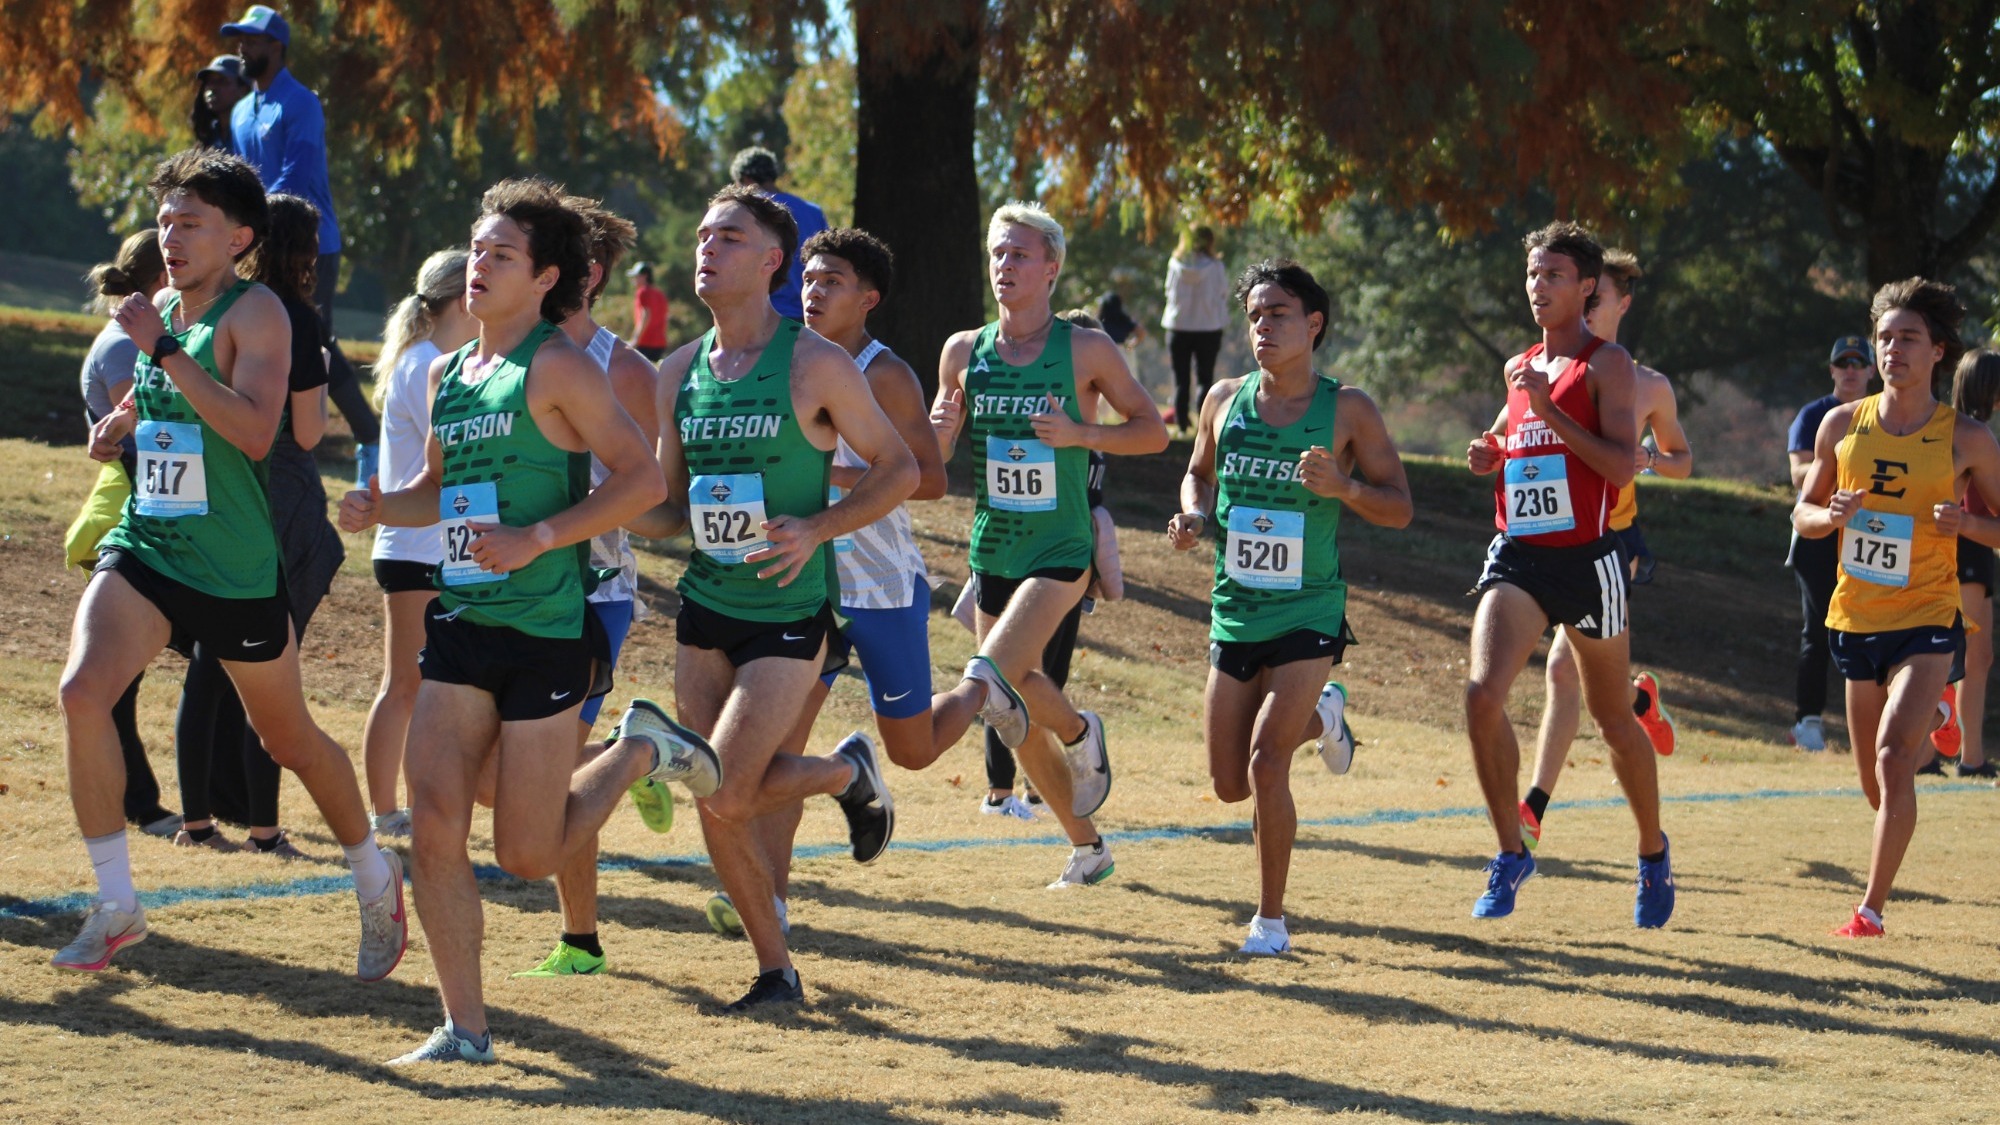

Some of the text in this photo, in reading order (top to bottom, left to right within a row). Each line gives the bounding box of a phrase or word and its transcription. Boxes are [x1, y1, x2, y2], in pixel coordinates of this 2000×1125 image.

[680, 415, 782, 444] STETSON
[1516, 419, 1547, 433] FLORIDA
[146, 458, 188, 496] 517
[997, 466, 1042, 496] 516
[1868, 458, 1909, 500] E
[1514, 486, 1558, 518] 236
[702, 510, 756, 544] 522
[447, 525, 482, 563] 52
[1237, 538, 1289, 572] 520
[1853, 537, 1898, 569] 175
